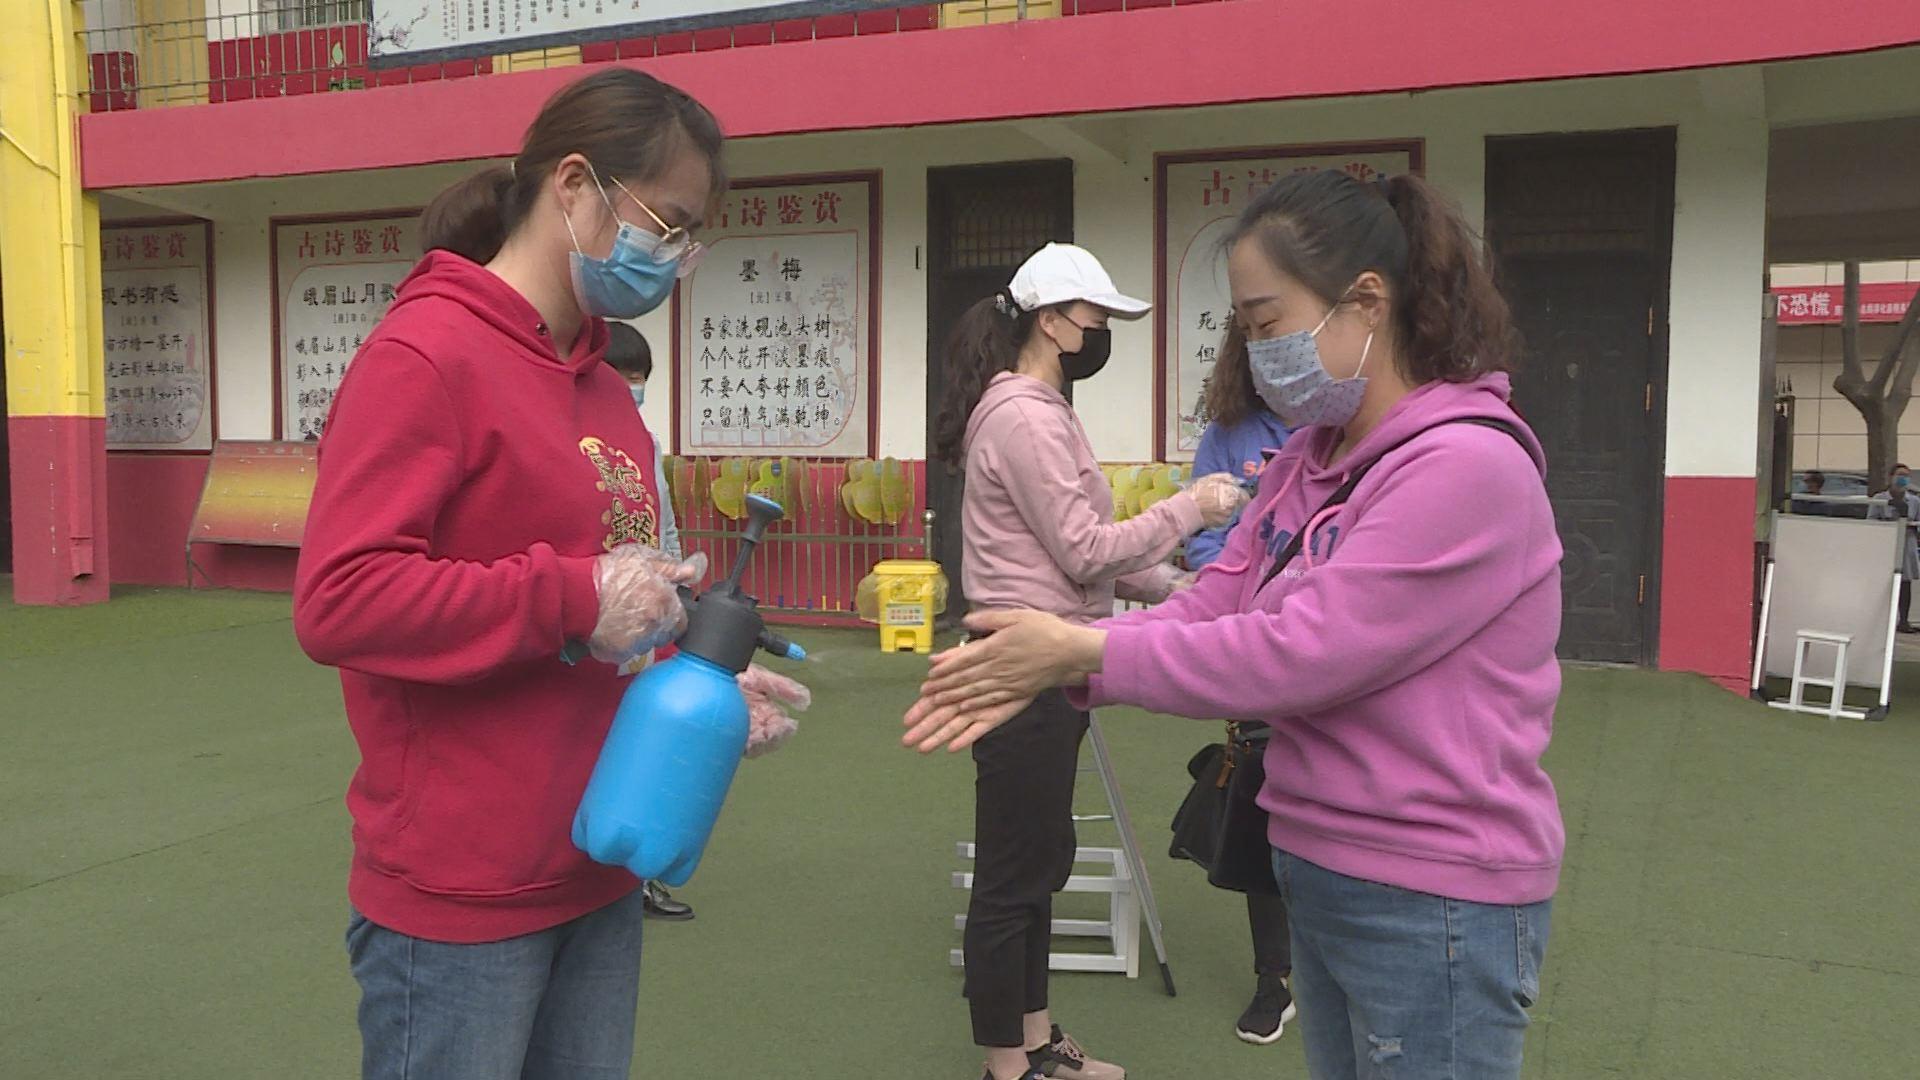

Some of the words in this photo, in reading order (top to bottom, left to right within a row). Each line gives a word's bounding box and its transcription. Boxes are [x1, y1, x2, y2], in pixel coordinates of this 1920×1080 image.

[299, 225, 402, 258] 古诗鉴赏
[1195, 343, 1217, 364] 但
